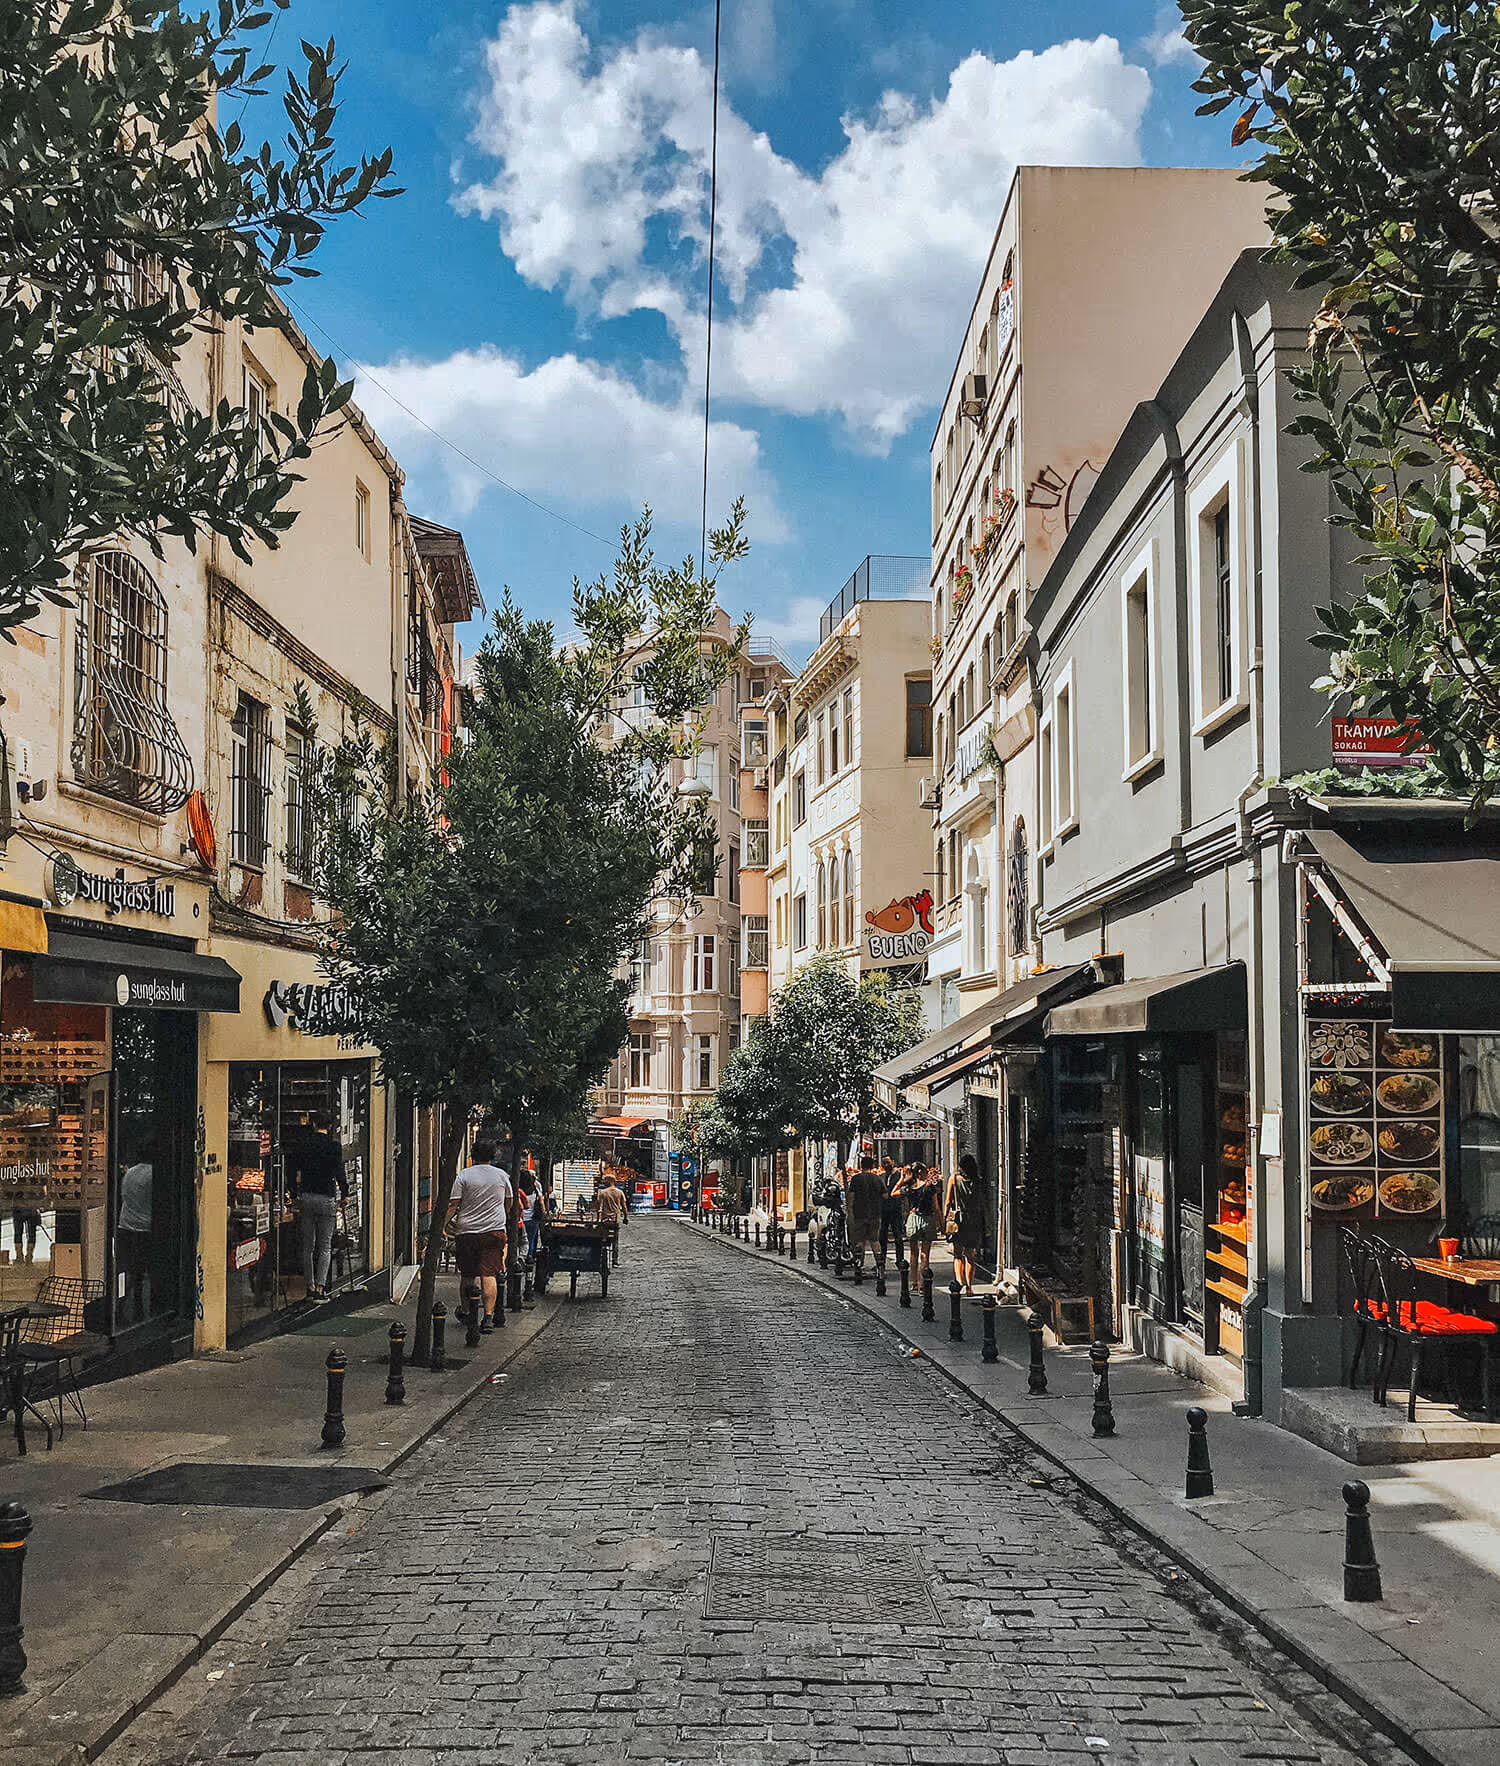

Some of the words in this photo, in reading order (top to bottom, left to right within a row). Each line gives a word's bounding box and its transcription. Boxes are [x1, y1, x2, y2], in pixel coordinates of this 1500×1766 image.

[1334, 741, 1367, 750] SOKAĞI
[81, 868, 151, 915] sunglass
[869, 930, 929, 959] BUENO
[131, 978, 170, 1006] sunglass
[171, 979, 185, 1002] hut
[0, 1159, 35, 1185] unglass
[36, 1158, 50, 1176] hut
